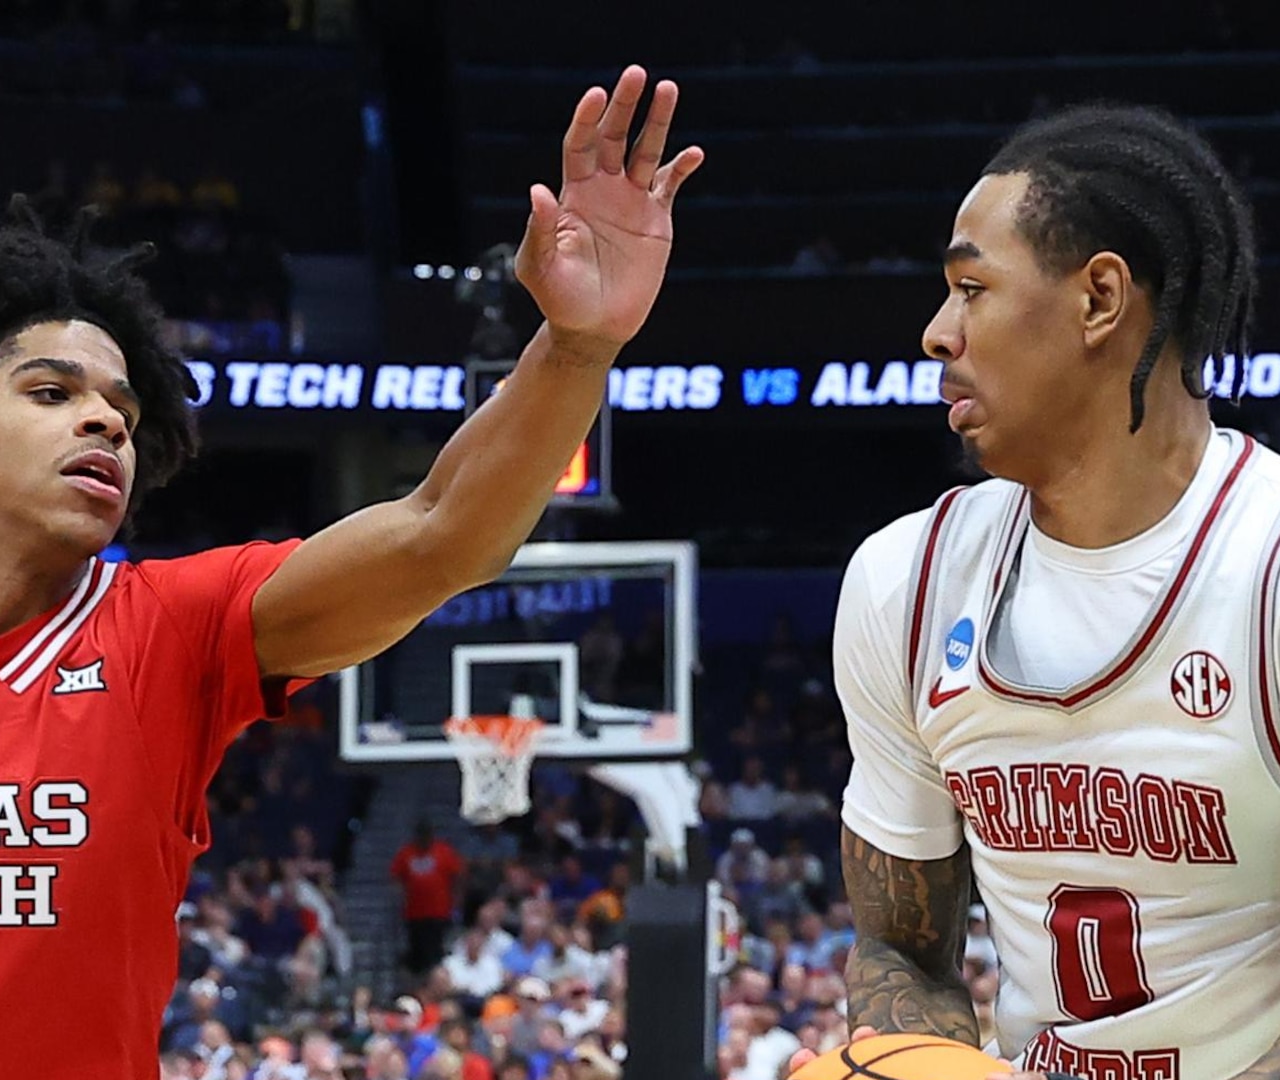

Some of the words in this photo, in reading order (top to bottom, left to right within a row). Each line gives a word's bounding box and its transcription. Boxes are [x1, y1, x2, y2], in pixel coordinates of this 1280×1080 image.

[226, 361, 364, 409] TECH
[742, 368, 799, 405] VS
[51, 656, 108, 695] XII
[1172, 652, 1229, 716] SEC
[1044, 882, 1155, 1022] 0
